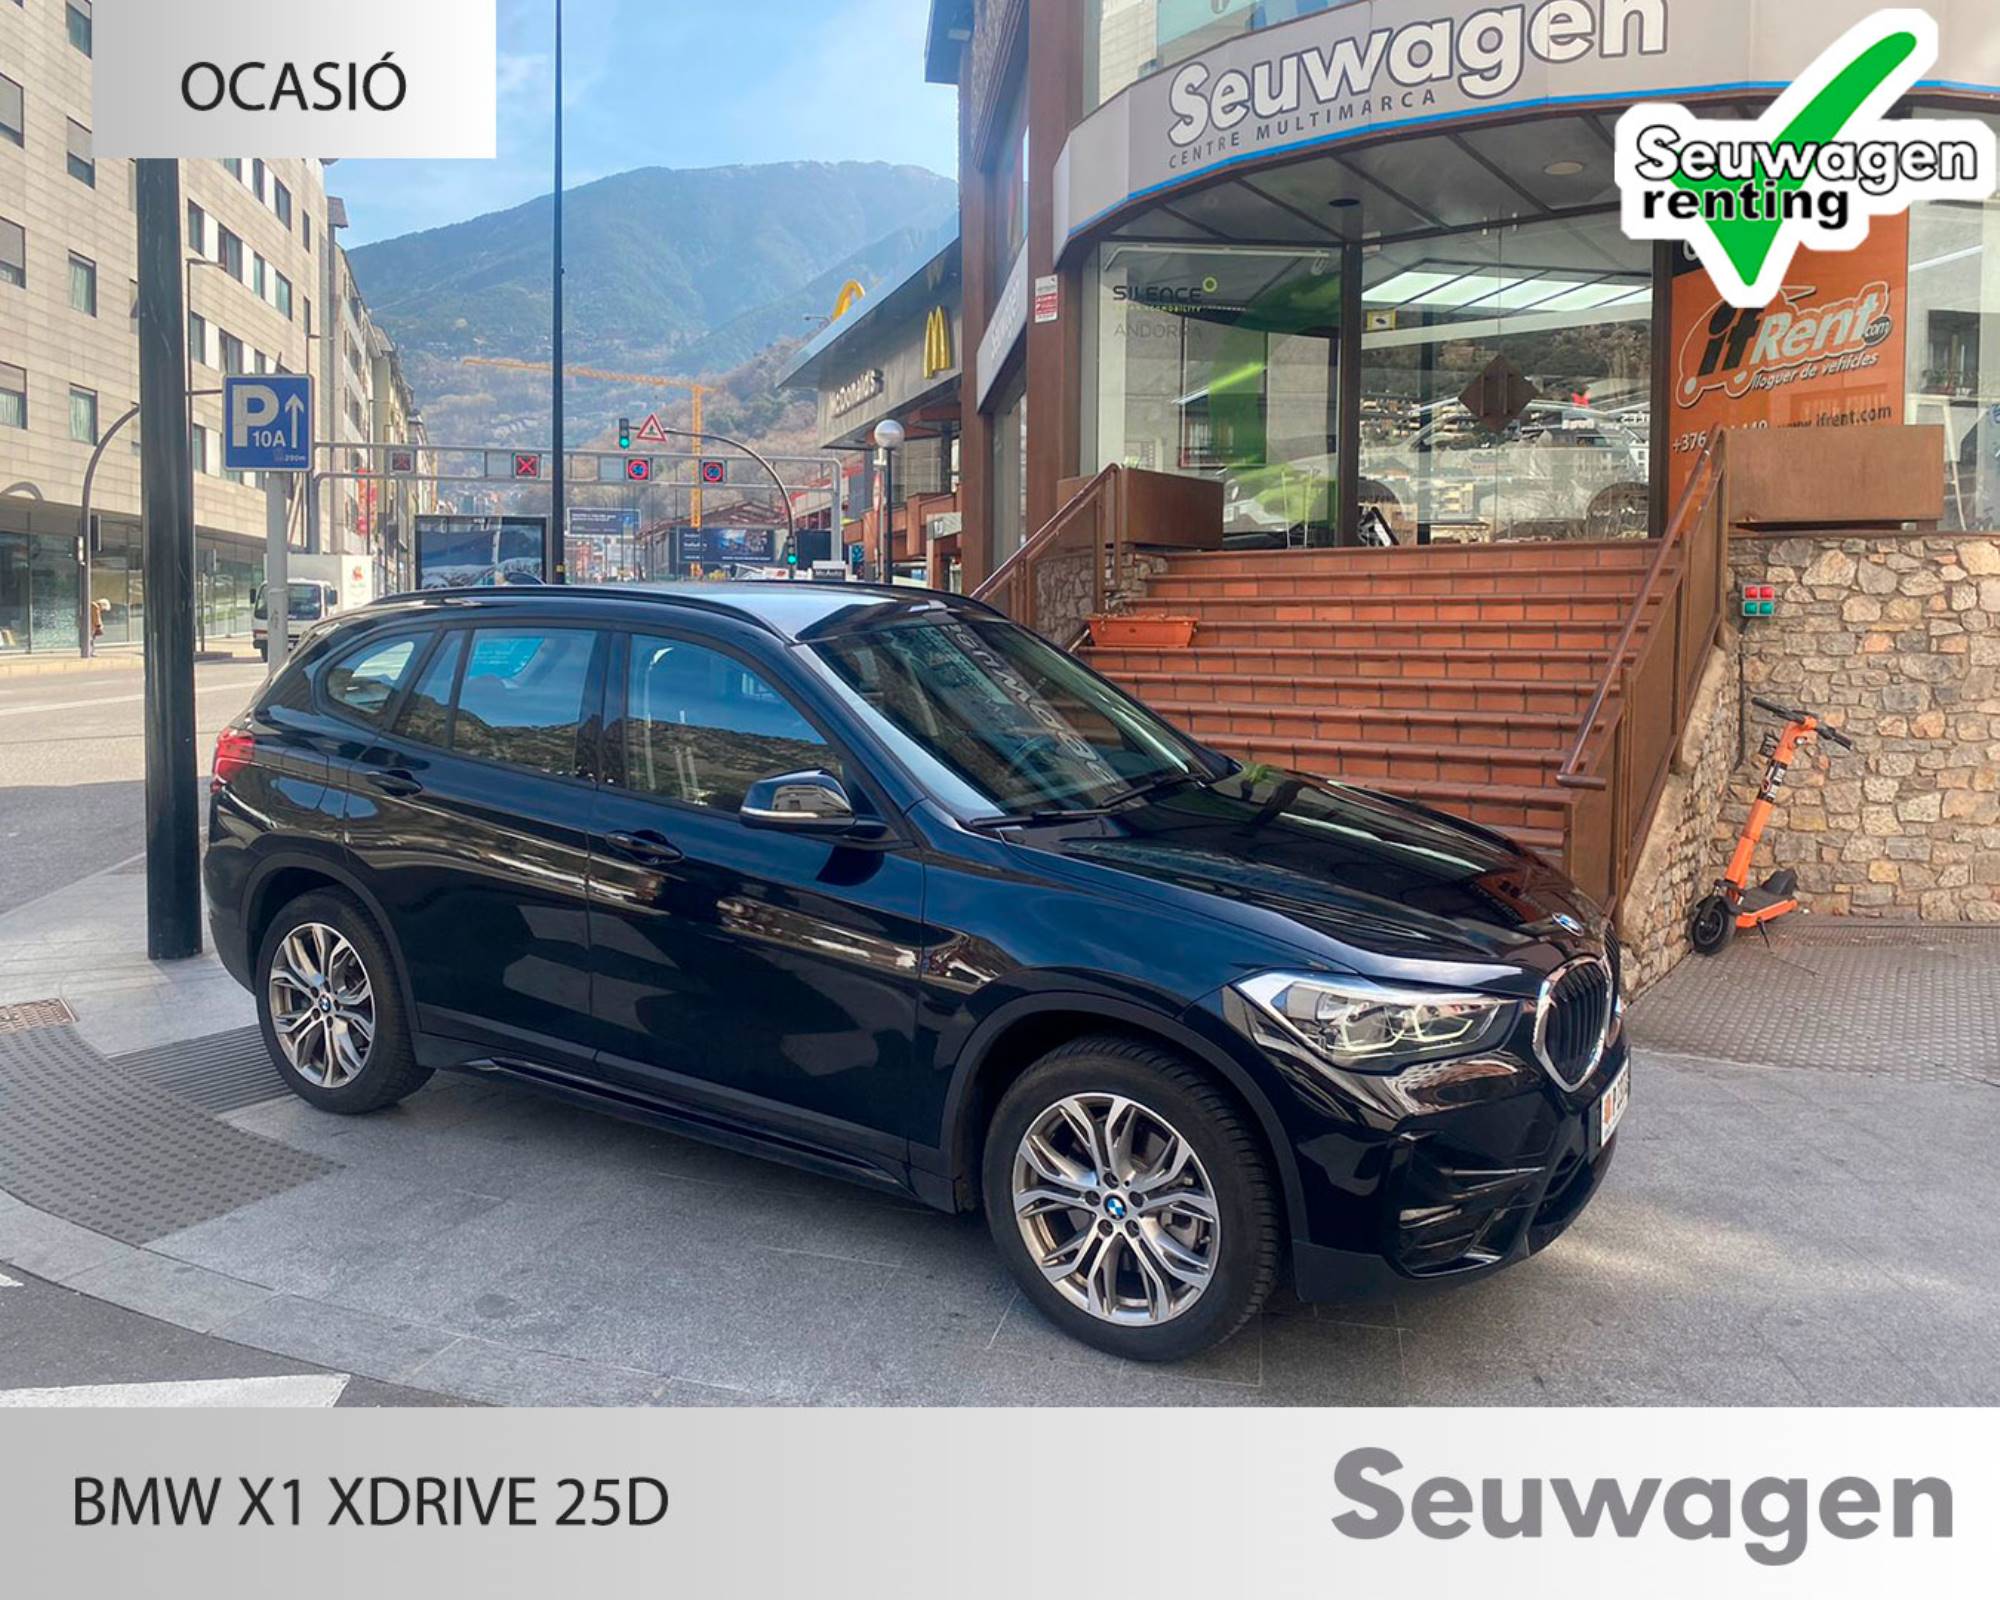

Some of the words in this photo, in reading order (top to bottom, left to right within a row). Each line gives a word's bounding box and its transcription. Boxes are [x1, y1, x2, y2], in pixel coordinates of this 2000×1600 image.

[1167, 0, 1669, 147] Seuwagen
[1168, 132, 1241, 169] CENTRE
[1256, 88, 1437, 142] MULTIMARCA
[1112, 285, 1202, 301] SILENCE
[1750, 369, 1797, 391] lloguer
[1799, 363, 1818, 379] de
[1821, 350, 1879, 378] vehicles
[232, 384, 280, 447] P
[251, 430, 286, 447] 10A
[1671, 430, 1708, 453] +376
